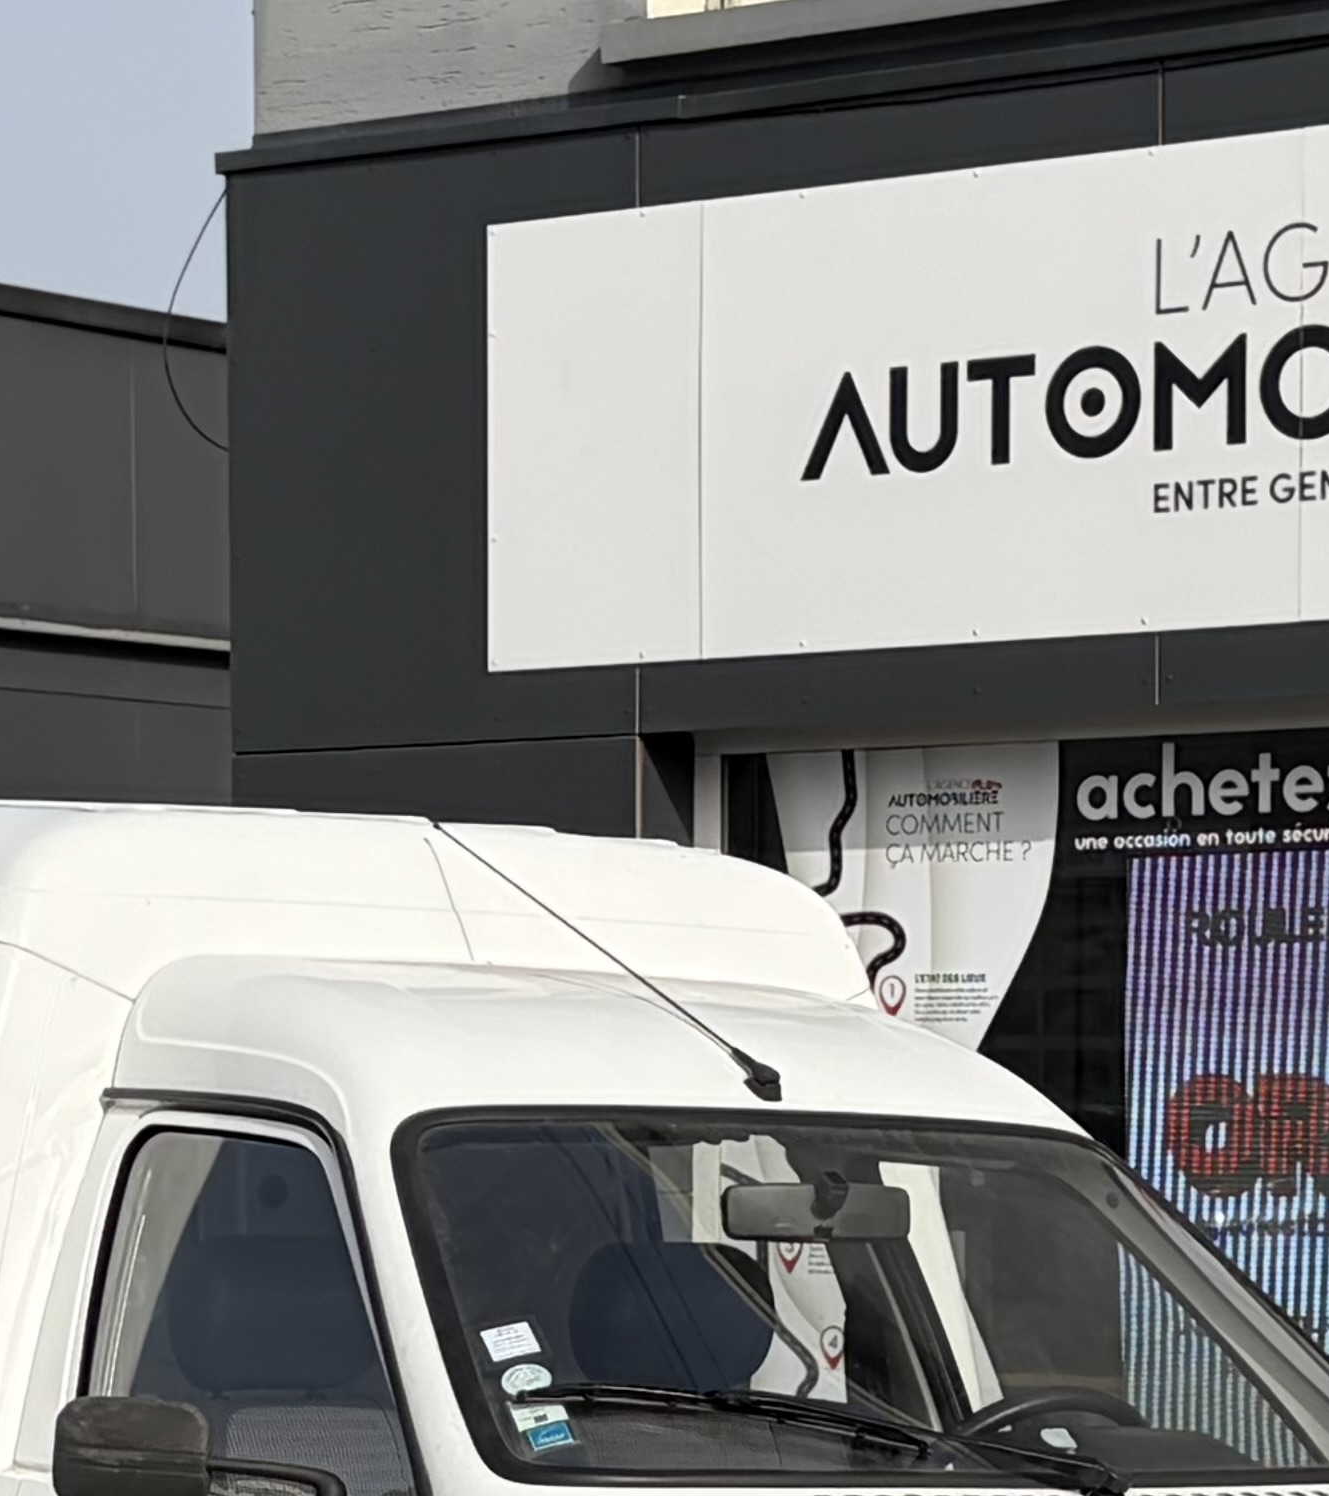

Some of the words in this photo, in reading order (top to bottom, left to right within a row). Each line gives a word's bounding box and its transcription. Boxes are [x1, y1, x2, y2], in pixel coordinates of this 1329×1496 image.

[1152, 475, 1259, 514] ENTRE
[885, 811, 1005, 836] COMMENT
[1074, 834, 1109, 851] une
[1113, 828, 1191, 850] occasion
[1196, 831, 1220, 847] en
[1225, 826, 1277, 846] toute
[885, 843, 915, 869] ÇA
[920, 840, 1014, 864] MARCHE
[827, 1335, 838, 1350] 4
